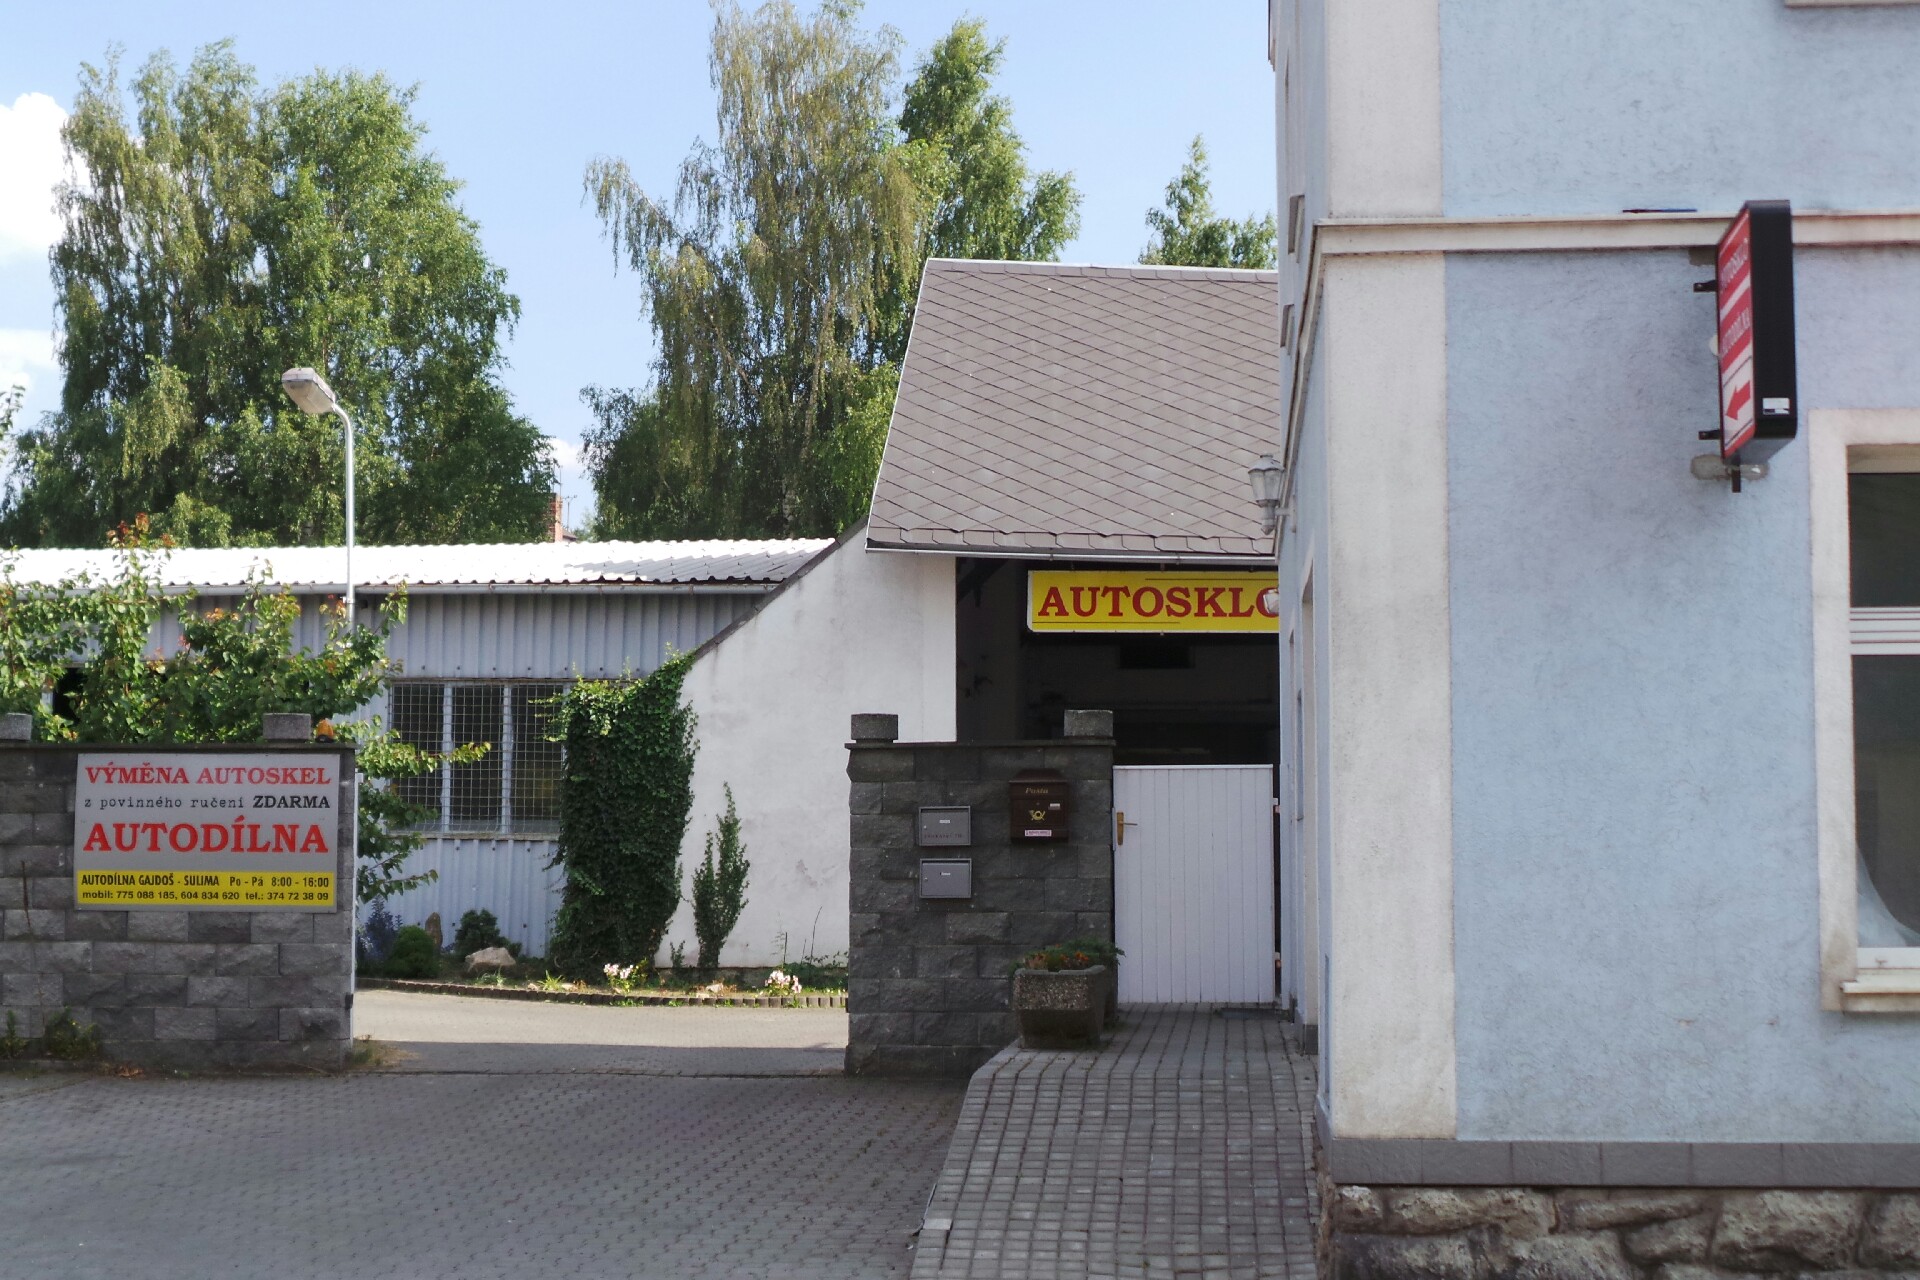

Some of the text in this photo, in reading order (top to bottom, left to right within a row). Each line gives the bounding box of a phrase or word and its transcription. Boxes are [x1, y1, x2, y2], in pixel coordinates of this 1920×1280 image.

[85, 761, 331, 785] VÝMĚNA AUTOSKEL
[100, 796, 182, 810] povinného
[191, 797, 244, 808] ručení
[253, 795, 331, 809] ZDARMA
[83, 815, 329, 853] AUTODÍLNA
[82, 872, 136, 886] AUTODÍLNA
[138, 873, 174, 886] GAJDOŠ
[184, 875, 219, 886] SULIMA
[230, 876, 241, 886] Po
[252, 877, 264, 887] Pá
[271, 876, 292, 887] 8:00
[303, 877, 329, 888] 16:00
[83, 890, 113, 899] mobil:
[116, 891, 134, 899] 775
[137, 891, 154, 899] 088
[158, 891, 178, 900] 185,
[181, 891, 199, 899] 604
[202, 891, 219, 900] 834
[222, 891, 240, 900] 620
[245, 892, 264, 900] tel.:
[267, 892, 284, 900] 374
[288, 892, 299, 900] 72
